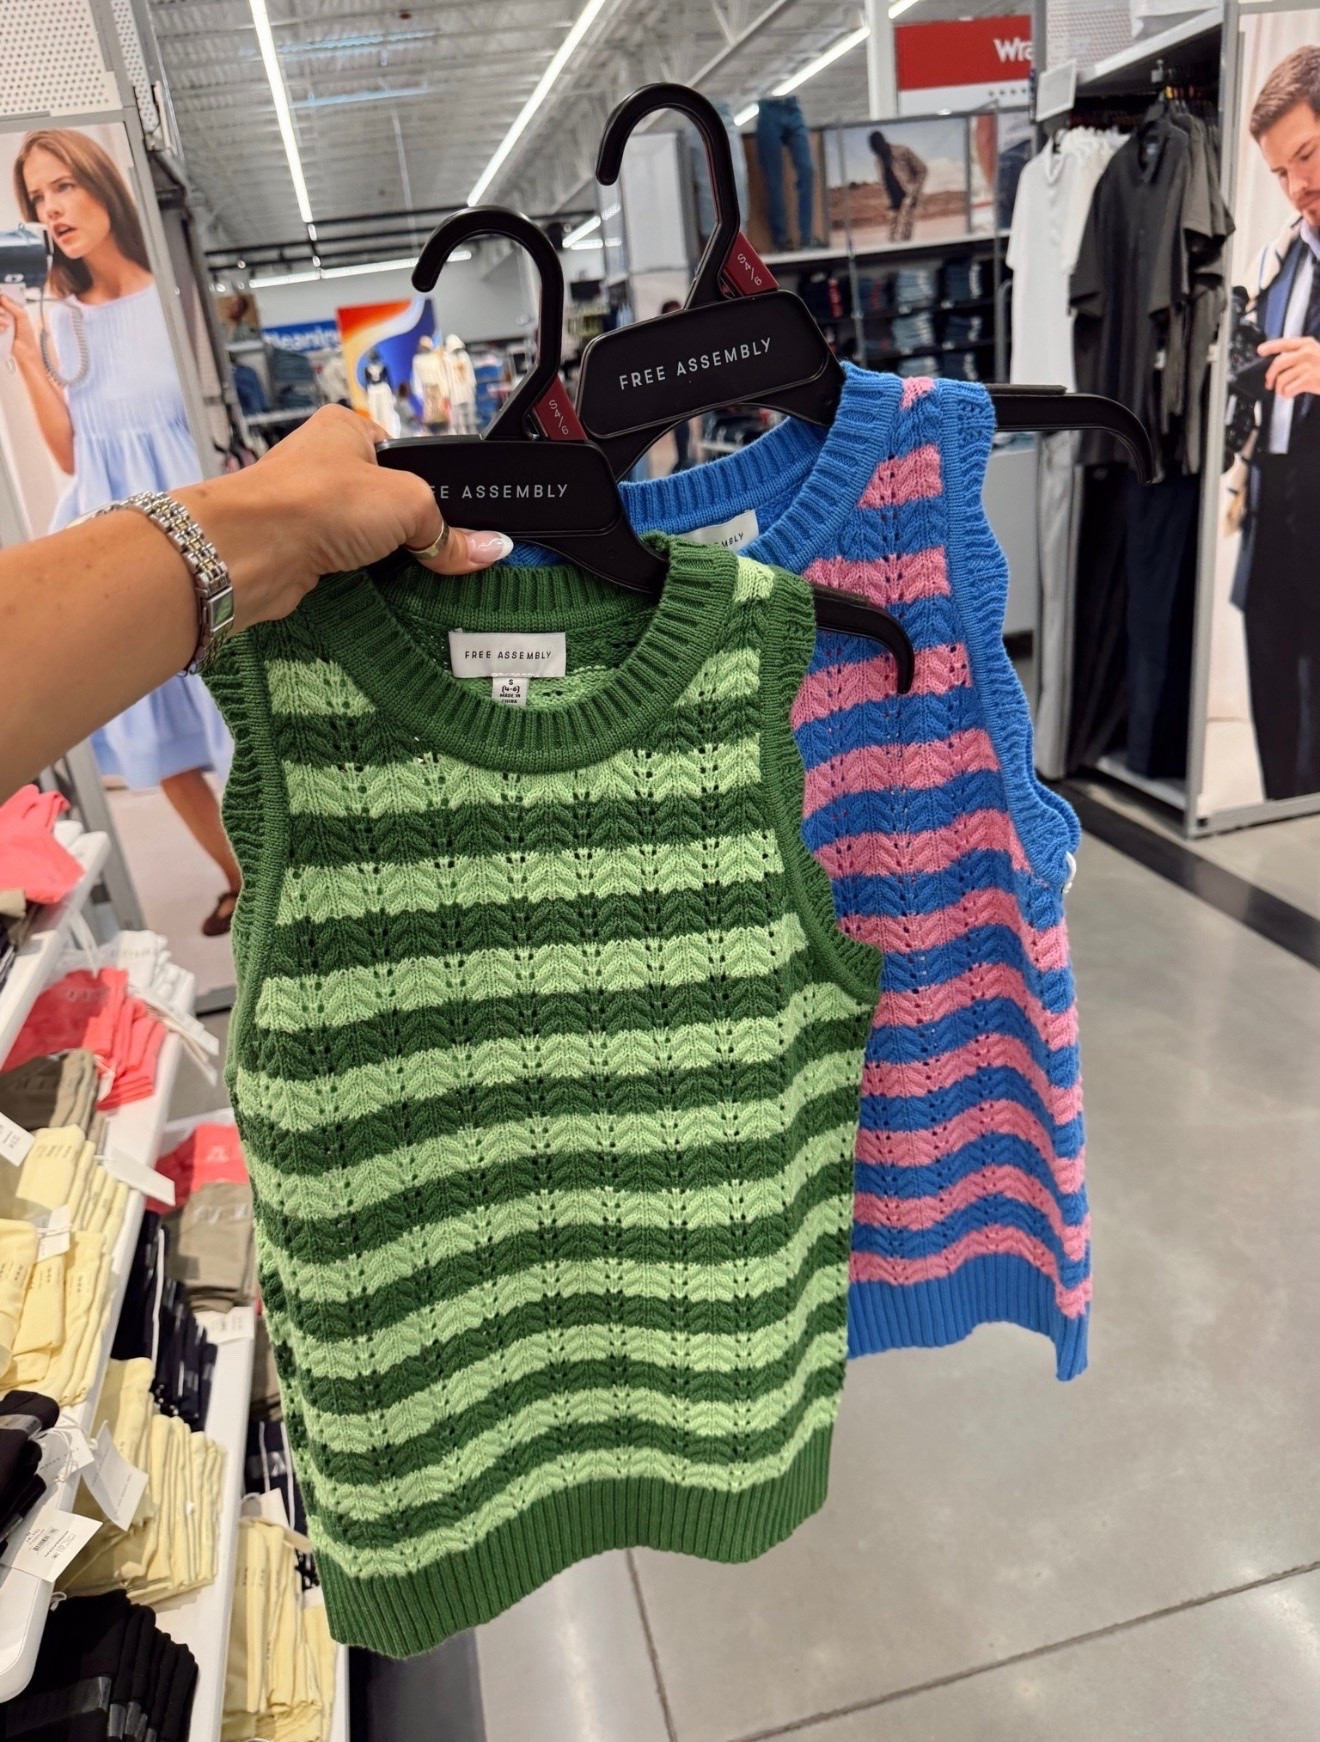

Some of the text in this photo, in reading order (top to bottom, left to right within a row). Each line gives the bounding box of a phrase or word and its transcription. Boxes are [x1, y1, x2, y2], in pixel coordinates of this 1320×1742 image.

[619, 337, 771, 390] FREE ASSEMBLY
[461, 484, 568, 499] ASSEMBLY
[715, 531, 744, 548] MBLY
[464, 650, 552, 660] FREE ASSEMBLY
